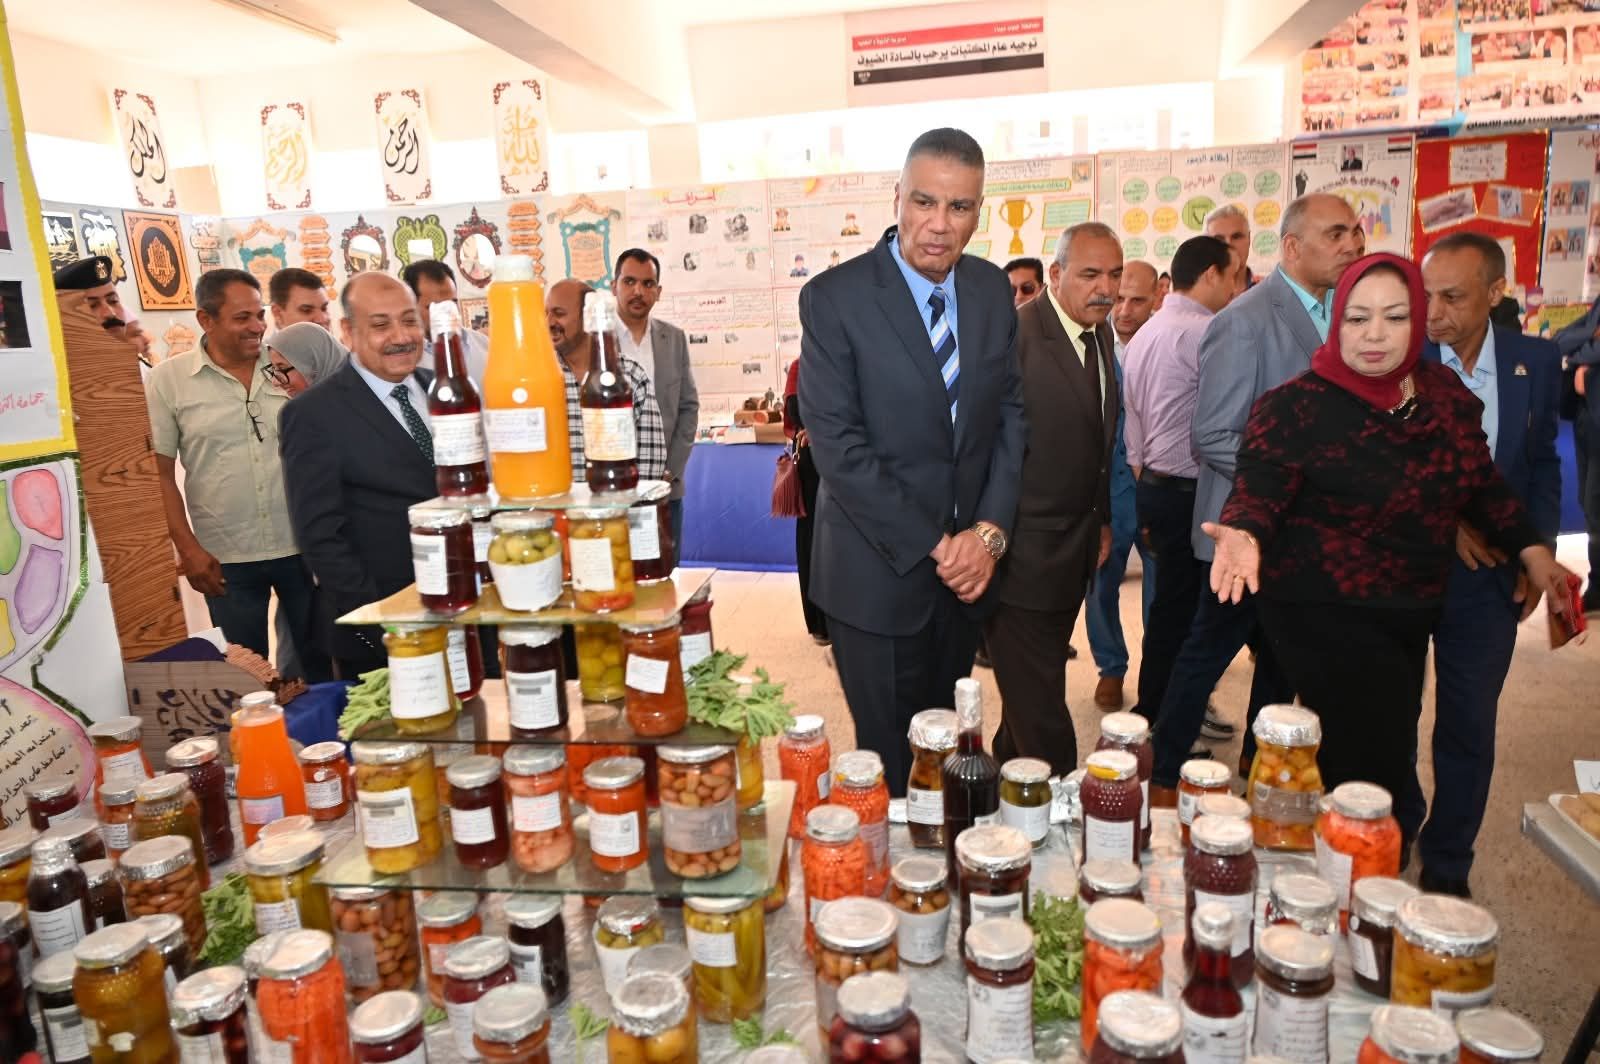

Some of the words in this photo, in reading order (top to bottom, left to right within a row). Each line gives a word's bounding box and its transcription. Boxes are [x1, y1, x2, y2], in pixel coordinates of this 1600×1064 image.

[950, 42, 990, 58] المكتبات
[992, 40, 1008, 54] عام
[1010, 37, 1038, 52] توجيه
[857, 53, 888, 68] الضيوف
[890, 49, 921, 63] بالسادة
[922, 48, 949, 62] يرحب
[384, 117, 419, 175] الرحمن
